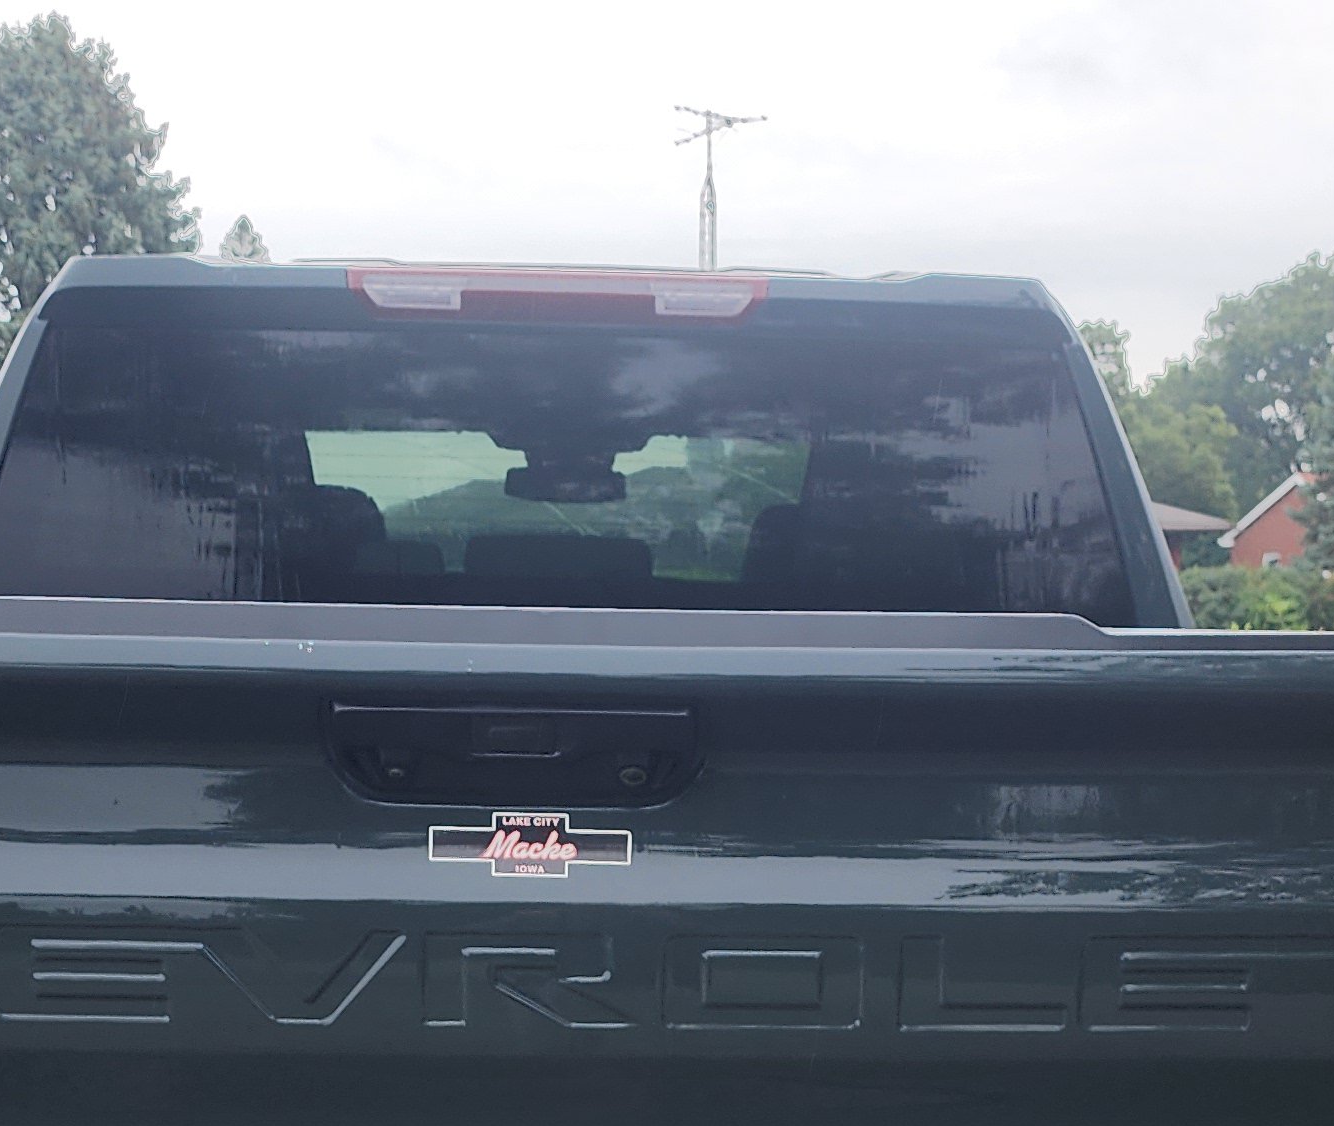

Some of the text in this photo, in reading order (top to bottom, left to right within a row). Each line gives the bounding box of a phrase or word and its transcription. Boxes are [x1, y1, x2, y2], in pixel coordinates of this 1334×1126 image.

[502, 816, 560, 827] LAKE CITY
[479, 829, 578, 860] Macke
[514, 864, 545, 873] IOWA
